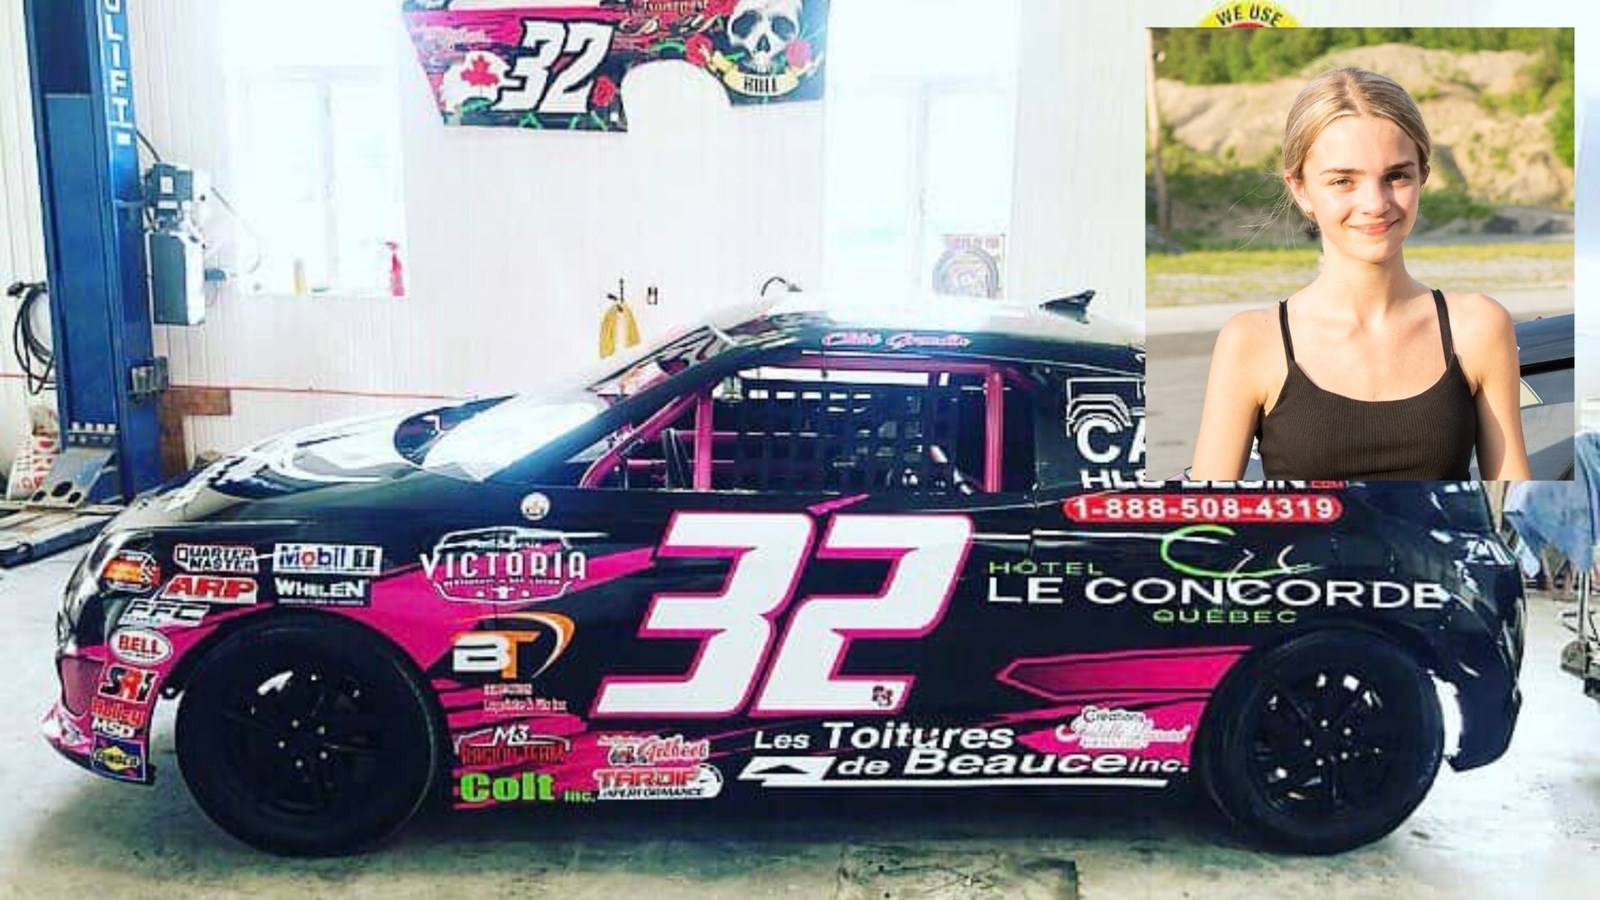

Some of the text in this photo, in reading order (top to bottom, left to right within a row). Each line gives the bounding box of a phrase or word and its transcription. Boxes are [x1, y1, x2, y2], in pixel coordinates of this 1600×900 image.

[1216, 4, 1283, 26] WE USE
[490, 19, 615, 114] 32
[1073, 498, 1337, 520] 1-888-508-4319
[280, 546, 346, 567] Mobil
[420, 551, 586, 581] VICTORIA
[989, 558, 1103, 575] HÔTEL
[163, 577, 257, 599] ARP
[275, 577, 366, 597] WHELEN
[988, 576, 1446, 608] LE CONCORDE
[592, 510, 974, 716] 32
[118, 634, 162, 655] BELL
[453, 632, 540, 679] BT
[92, 715, 137, 738] MSD
[754, 721, 1015, 751] Les Toitures
[837, 756, 891, 776] de
[904, 748, 1127, 775] Beauce
[460, 772, 555, 801] Colt
[597, 770, 700, 789] TARDIF
